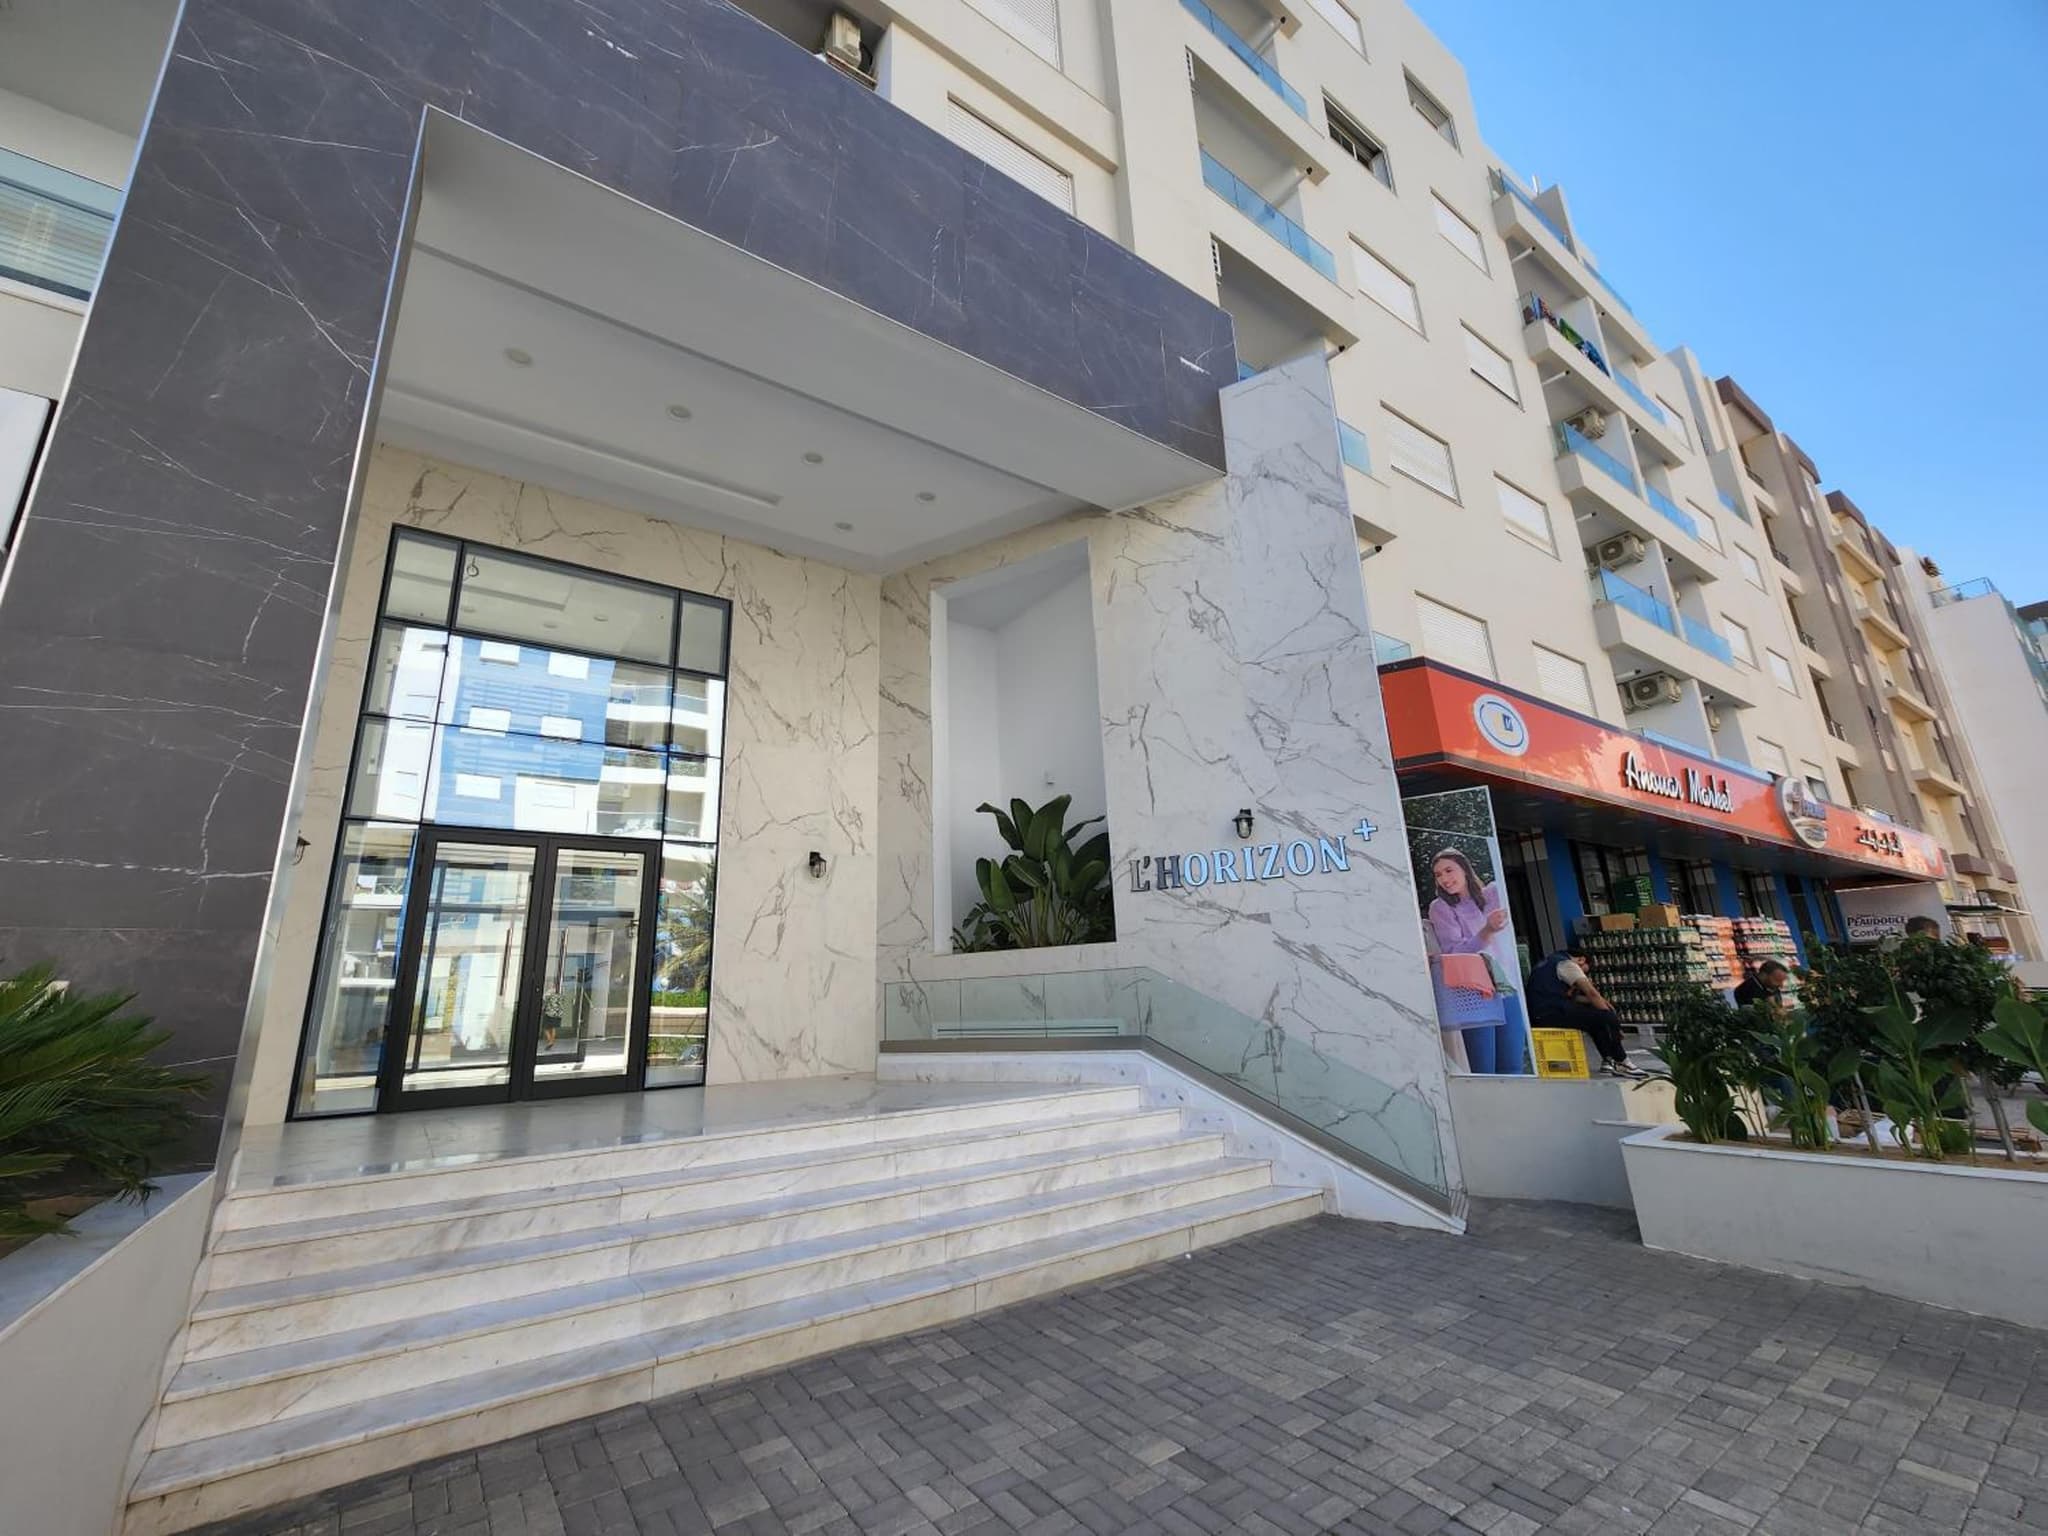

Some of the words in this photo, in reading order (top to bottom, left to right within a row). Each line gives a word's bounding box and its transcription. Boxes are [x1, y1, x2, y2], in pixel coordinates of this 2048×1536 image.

[1626, 750, 1684, 800] Anouar
[1688, 767, 1735, 813] Market
[1851, 926, 1892, 937] Confort
